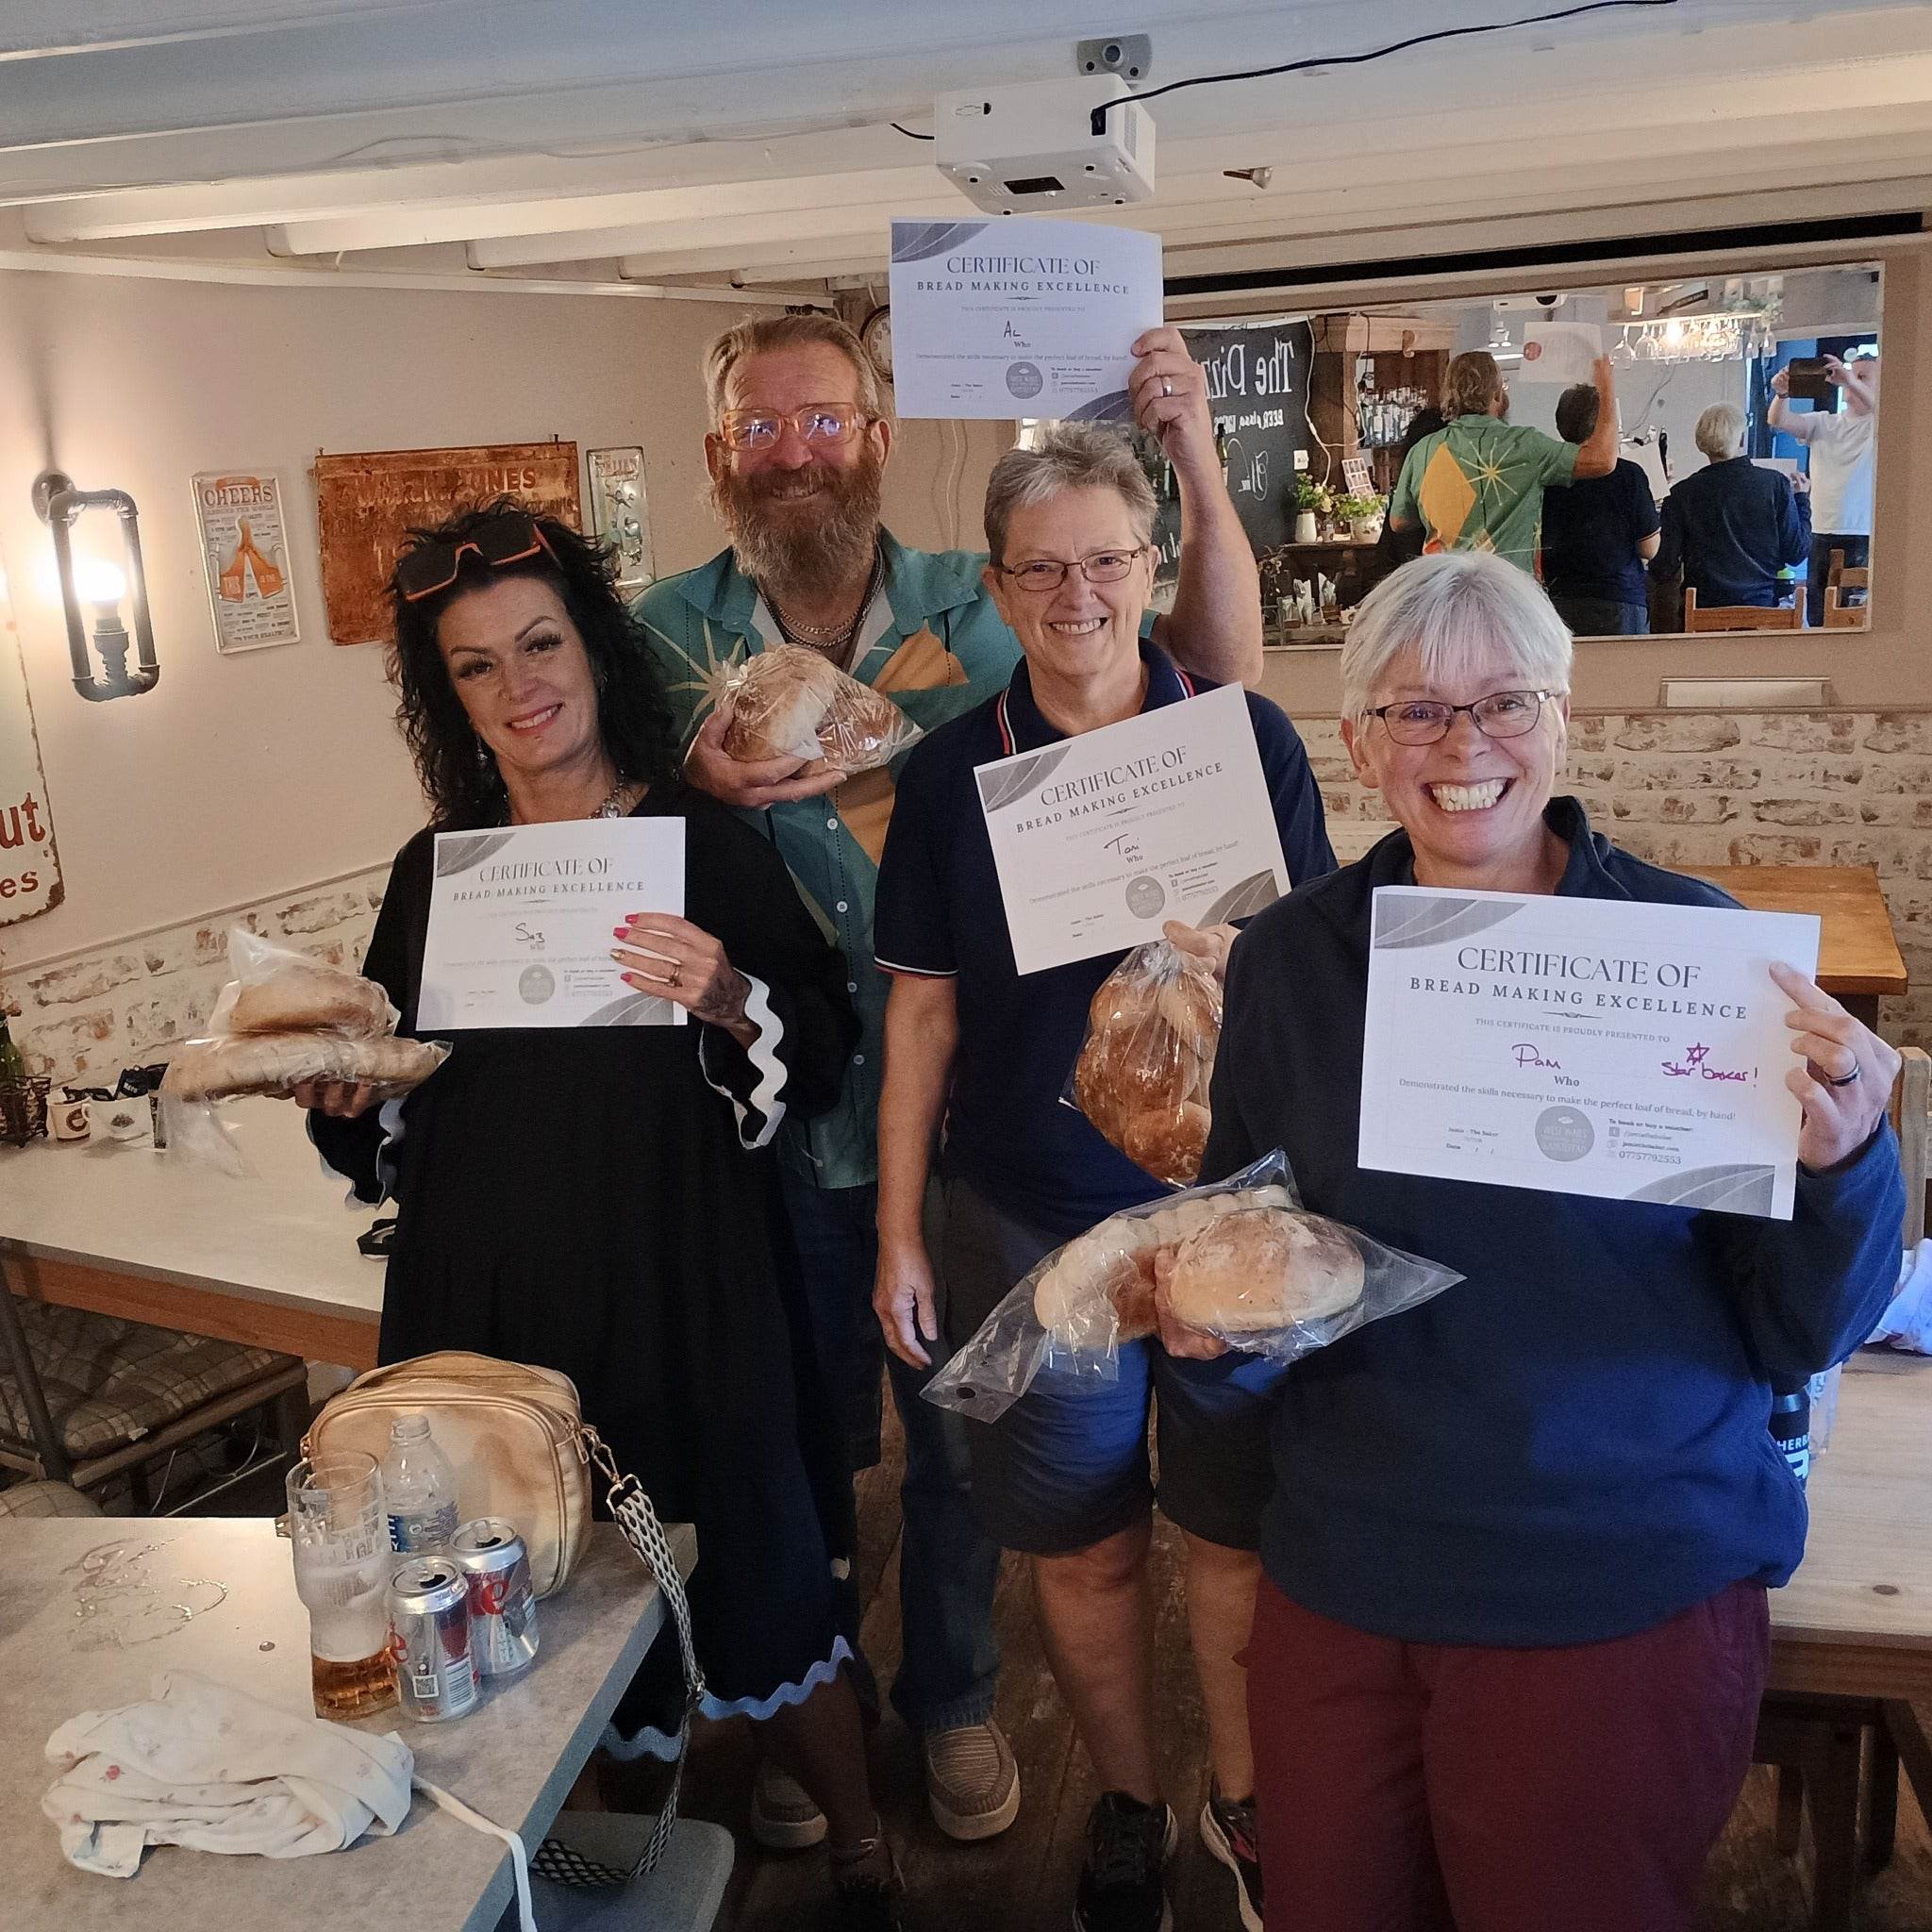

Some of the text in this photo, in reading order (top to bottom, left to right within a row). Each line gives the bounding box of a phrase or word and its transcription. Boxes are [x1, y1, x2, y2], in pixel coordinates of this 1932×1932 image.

[946, 256, 1100, 275] CERTIFICATE OF
[917, 281, 1130, 295] BREAD MAKING EXCELLENCE
[204, 484, 274, 507] CHEERS
[1041, 745, 1188, 807] CERTIFICATE OF
[1016, 762, 1224, 834] BREAD MAKING EXCELLENCE
[479, 858, 613, 883] CERTIFICATE OF
[1125, 854, 1143, 863] Who
[453, 881, 645, 902] BREAD MAKING EXCELLENCE
[1457, 946, 1701, 989] CERTIFICATE OF
[1409, 976, 1747, 1020] BREAD MAKING EXCELLENCE
[1474, 1018, 1495, 1026] THIS
[1496, 1020, 1550, 1032] CERTIFICATE
[1562, 1026, 1604, 1037] PROUDLY
[1605, 1029, 1655, 1041] PRESENTED
[1657, 1034, 1670, 1042] TO
[1511, 1043, 1561, 1070] Pam
[1554, 1075, 1580, 1087] Who
[1399, 1078, 1737, 1121] Demonstrated the skills necessary to make the perfect loaf of bread, by hand!
